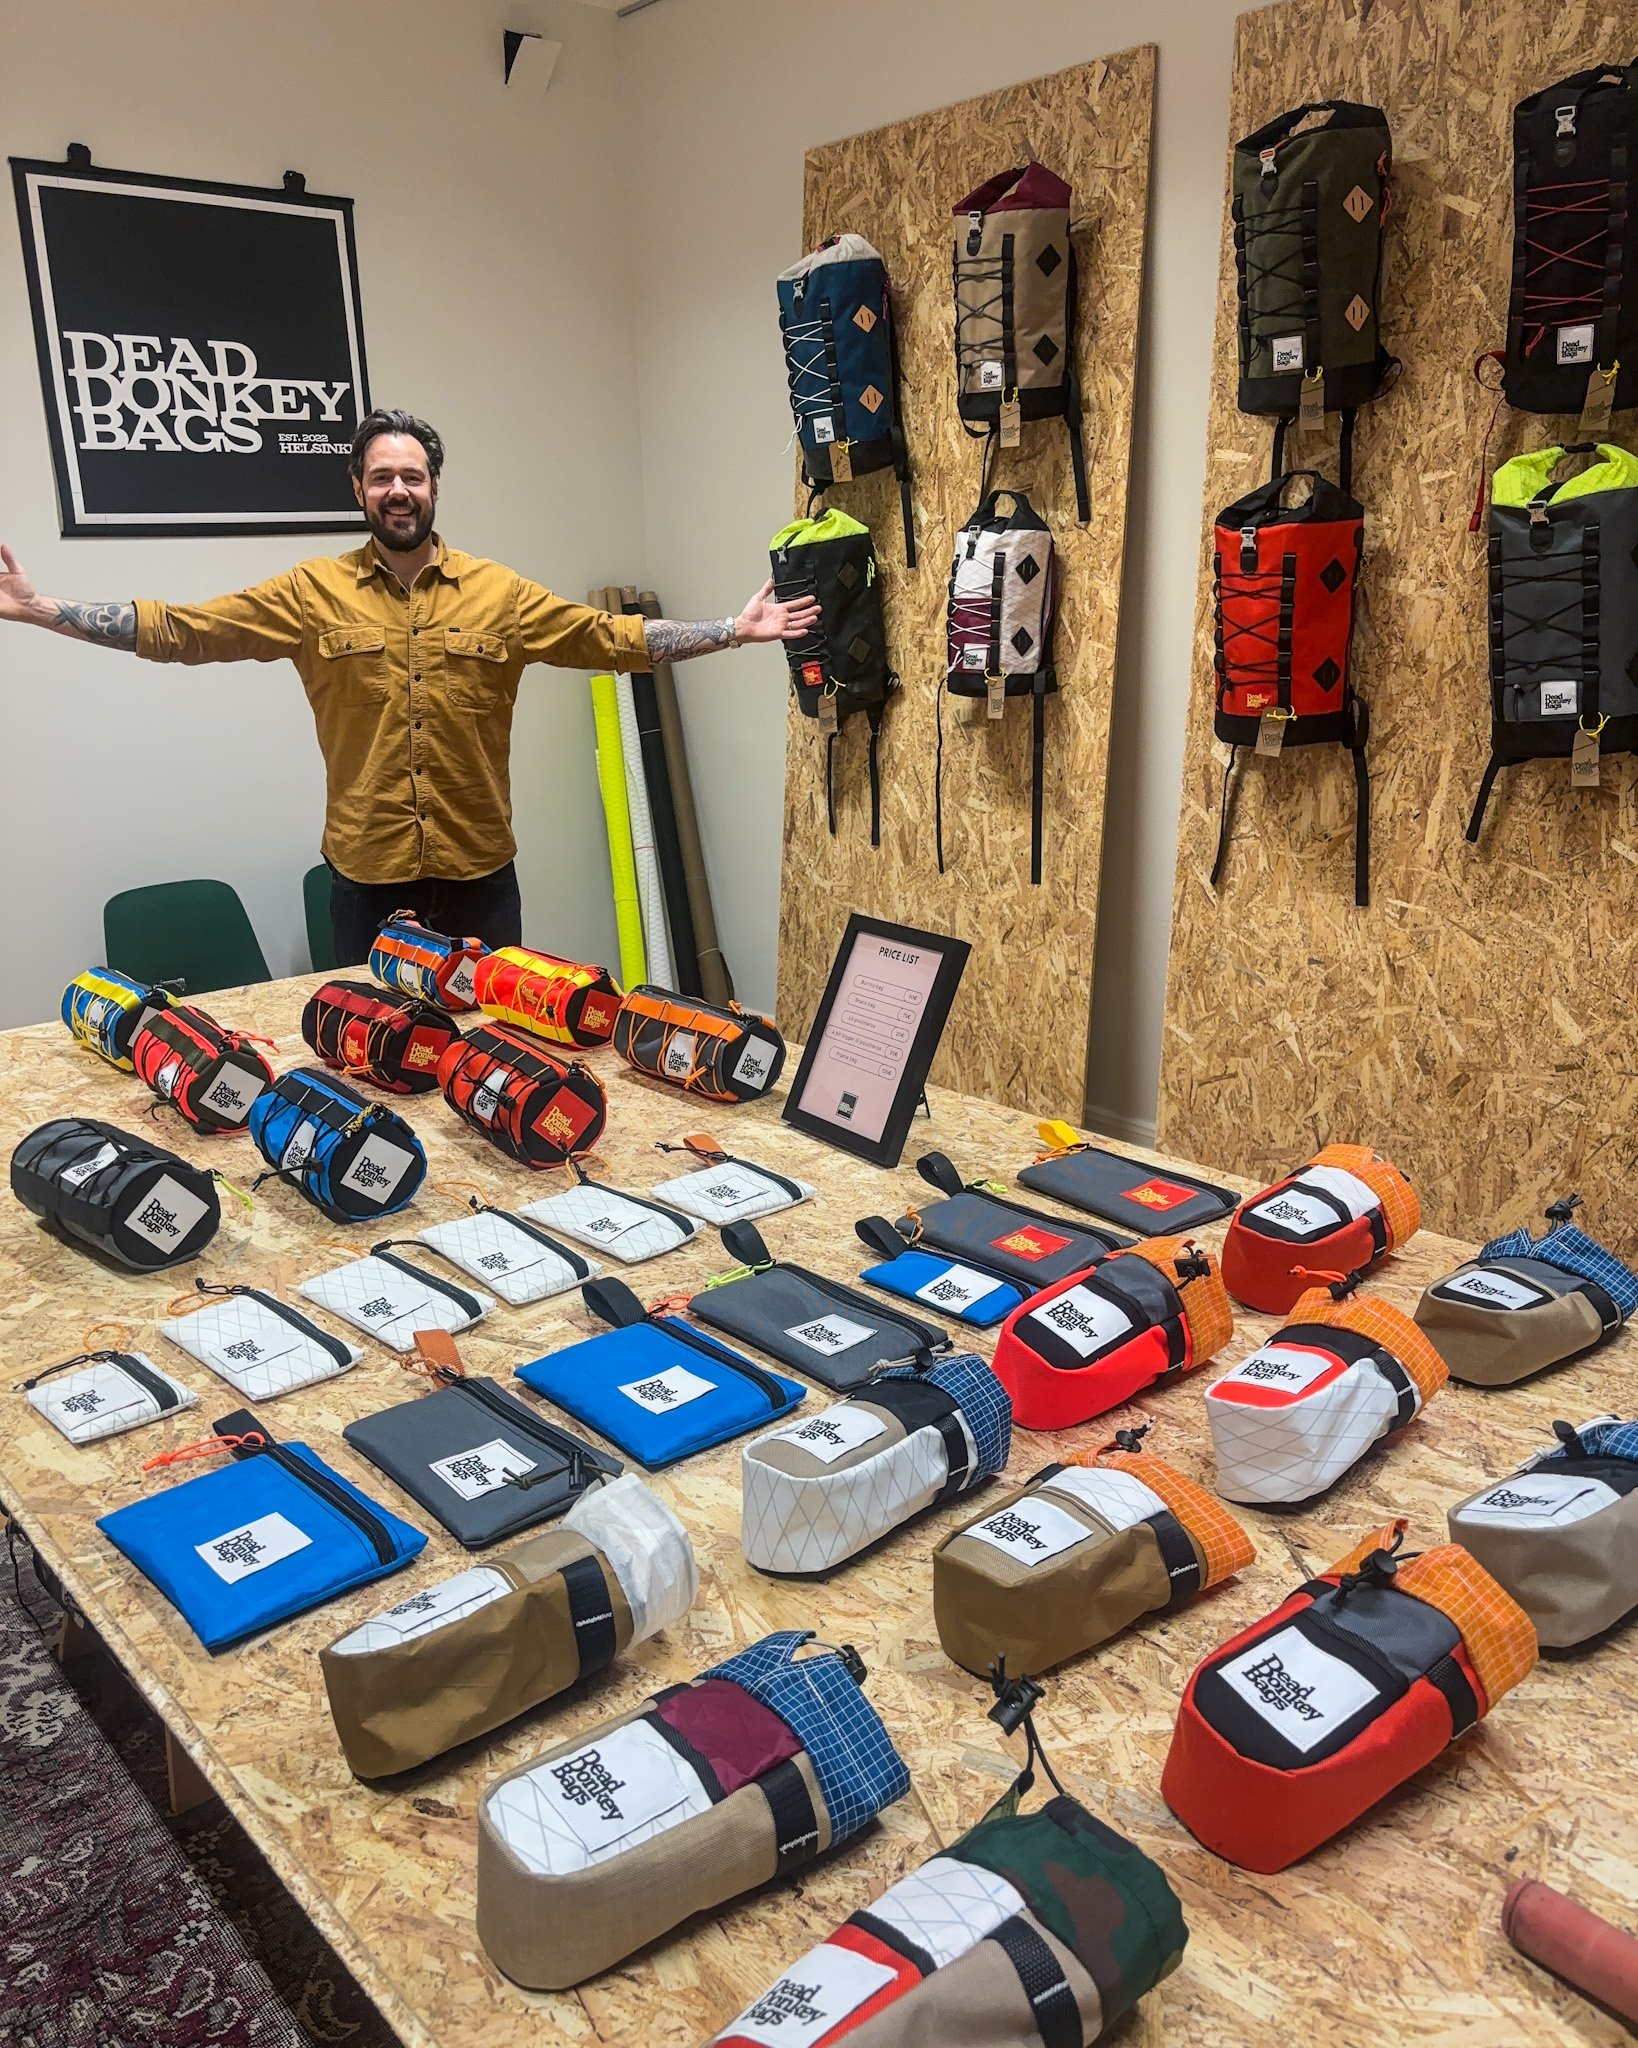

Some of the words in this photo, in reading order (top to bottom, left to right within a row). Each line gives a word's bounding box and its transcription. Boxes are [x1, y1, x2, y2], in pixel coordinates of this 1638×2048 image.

[63, 331, 257, 383] DEAD
[1562, 344, 1588, 353] Donkey
[68, 369, 350, 421] DONKEY
[74, 406, 263, 453] BAGS
[278, 434, 301, 442] EST.
[302, 434, 328, 442] 2022
[1546, 697, 1571, 705] Donkey
[879, 946, 902, 960] PRICE
[902, 952, 920, 964] LIST
[586, 1012, 610, 1026] Donkey
[588, 1006, 604, 1018] Dead
[584, 1017, 600, 1028] Bags
[410, 1048, 440, 1063] Donkey
[412, 1042, 434, 1054] Dead
[671, 1050, 685, 1061] Dead
[408, 1053, 429, 1066] Bags
[742, 1059, 765, 1077] Donkey
[745, 1054, 761, 1067] Dead
[740, 1066, 755, 1078] Bags
[213, 1087, 245, 1109] Donkey
[217, 1080, 241, 1099] Dead
[209, 1094, 231, 1109] Bags
[546, 1112, 575, 1139] Donkey
[552, 1106, 572, 1126] Dead
[541, 1119, 561, 1137] Bags
[360, 1156, 386, 1175] Dead
[351, 1170, 375, 1187] Bags
[356, 1163, 391, 1188] Donkey
[148, 1198, 177, 1223] Dead
[1264, 1206, 1291, 1220] Bags
[1272, 1203, 1313, 1225] Donkey
[1279, 1201, 1308, 1216] Dead
[137, 1213, 163, 1234] Bags
[142, 1204, 180, 1236] Donkey
[494, 1252, 514, 1264] Dead
[928, 1286, 953, 1300] Bags
[935, 1282, 972, 1301] Donkey
[942, 1279, 969, 1293] Dead
[378, 1296, 399, 1309] Dead
[1059, 1300, 1094, 1324] Dead
[1045, 1309, 1076, 1331] Bags
[1052, 1303, 1098, 1338] Donkey
[798, 1329, 824, 1341] Bags
[805, 1325, 843, 1346] Donkey
[814, 1324, 841, 1338] Dead
[223, 1345, 243, 1359] Bags
[233, 1342, 260, 1363] Donkey
[243, 1339, 265, 1354] Dead
[1239, 1368, 1275, 1380] Bags
[1245, 1362, 1302, 1380] Donkey
[1250, 1360, 1290, 1370] Dead
[83, 1389, 106, 1405] Dead
[633, 1385, 657, 1401] Bags
[642, 1382, 677, 1404] Donkey
[650, 1379, 678, 1396] Dead
[61, 1397, 81, 1413] Bags
[72, 1393, 98, 1415] Donkey
[446, 1461, 472, 1480] Bags
[456, 1458, 492, 1486] Donkey
[466, 1455, 495, 1474] Dead
[980, 1523, 1019, 1542] Bags
[998, 1512, 1041, 1534] Dead
[236, 1530, 266, 1554] Dead
[988, 1517, 1048, 1549] Donkey
[213, 1540, 238, 1563] Bags
[224, 1535, 260, 1567] Donkey
[1262, 1653, 1316, 1700] Dead
[1241, 1666, 1289, 1711] Bags
[1252, 1659, 1324, 1721] Donkey
[578, 1749, 626, 1794] Dead
[551, 1763, 592, 1806] Bags
[565, 1756, 624, 1820] Donkey
[772, 1978, 822, 2003] Dead
[759, 1990, 827, 2026] Donkey
